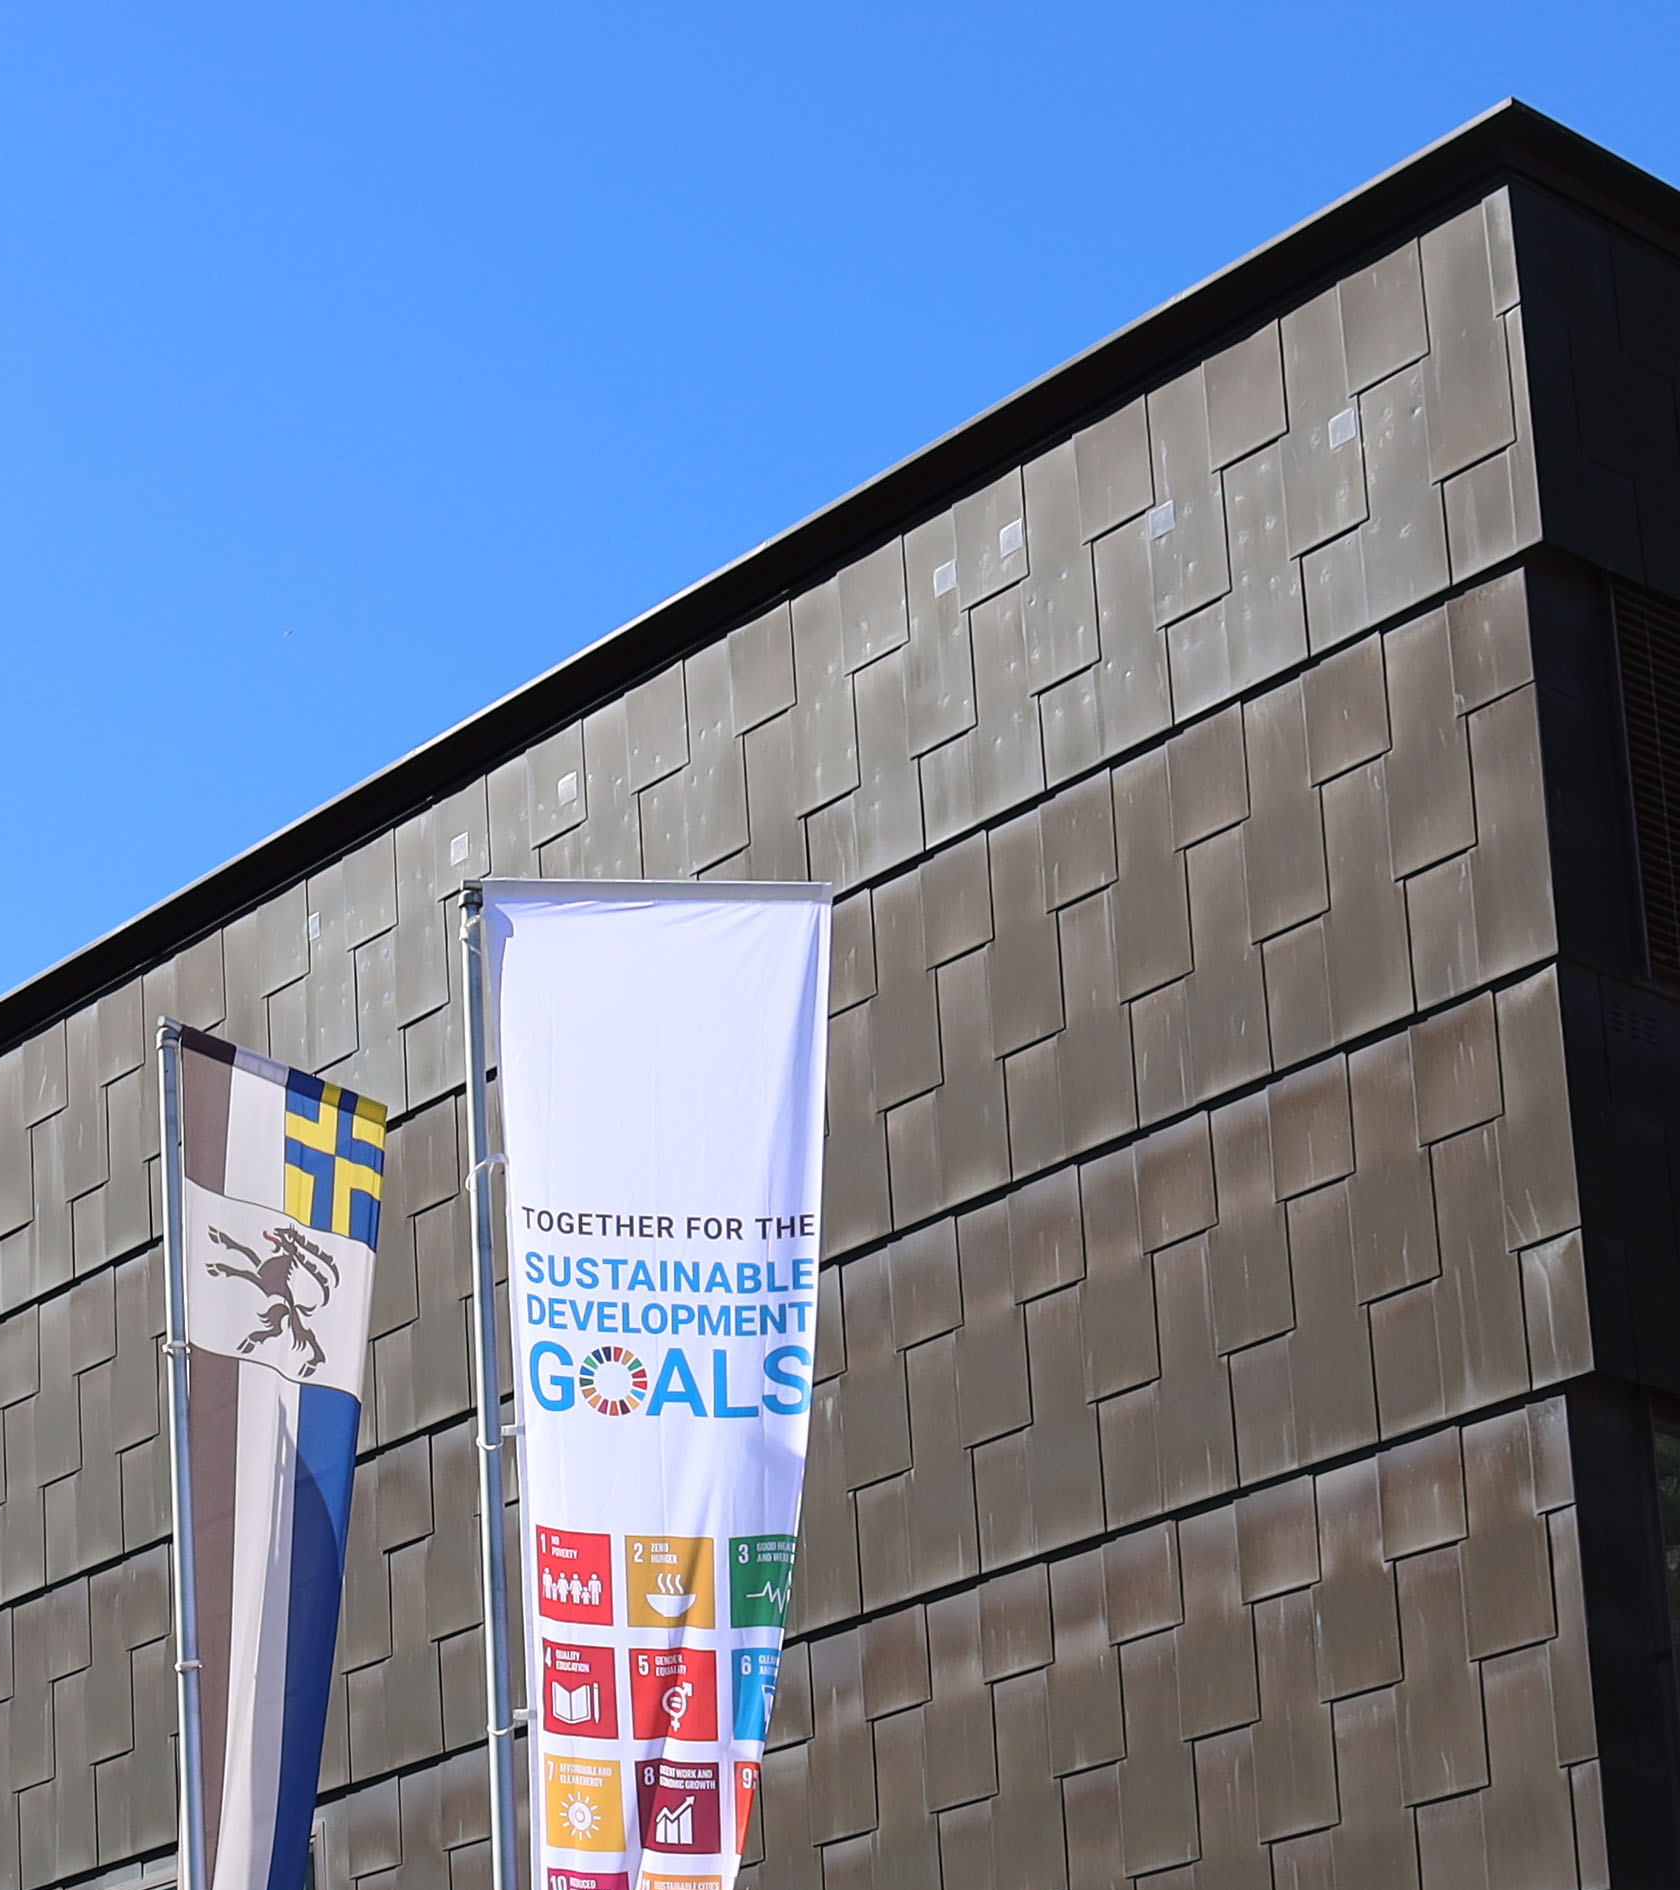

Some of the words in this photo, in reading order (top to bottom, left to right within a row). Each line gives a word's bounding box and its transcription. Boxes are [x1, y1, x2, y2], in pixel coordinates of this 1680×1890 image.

[521, 1205, 674, 1239] TOGETHER
[686, 1216, 744, 1241] FOR
[755, 1213, 816, 1240] THE
[524, 1250, 815, 1295] SUSTAINABLE
[526, 1292, 814, 1337] DEVELOPMENT
[529, 1340, 813, 1419] GOALS
[539, 1532, 548, 1554] 1
[632, 1542, 644, 1564] 2
[650, 1542, 669, 1553] ZERO
[738, 1543, 750, 1564] 3
[543, 1647, 552, 1668] 4
[638, 1655, 649, 1676] 5
[740, 1654, 752, 1676] 6
[547, 1760, 555, 1782] 7
[643, 1766, 655, 1787] 8
[741, 1767, 752, 1789] 9
